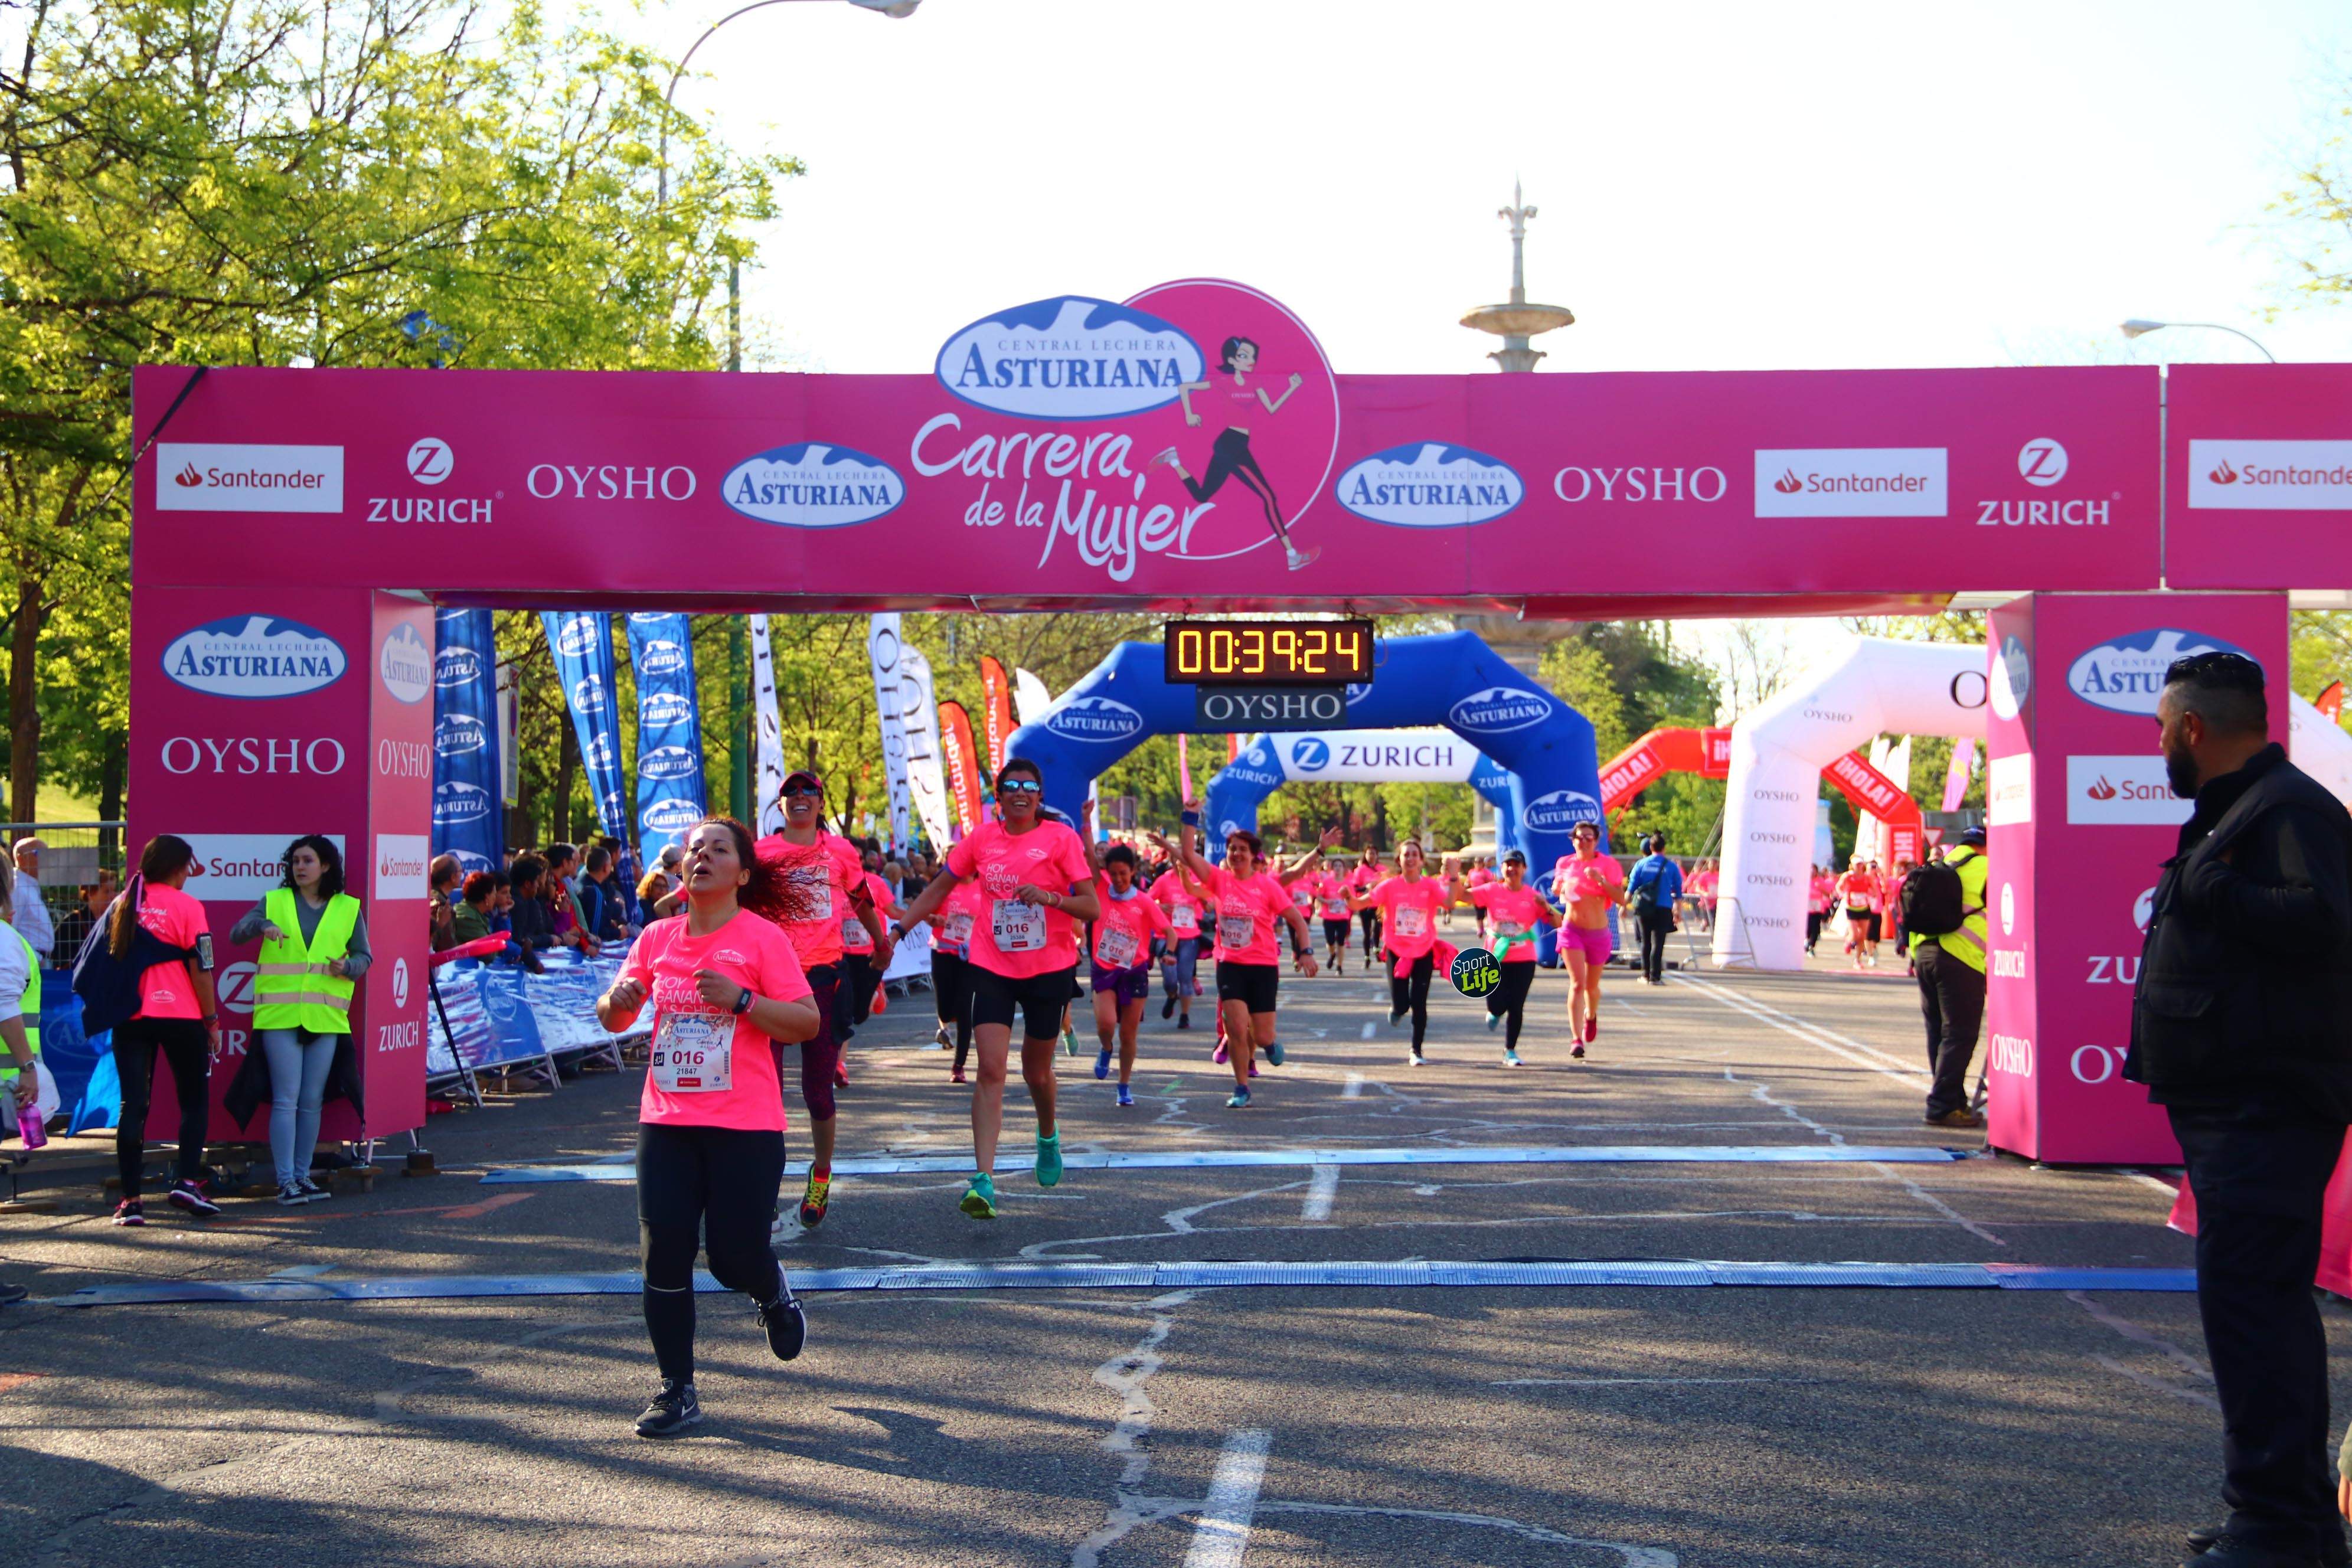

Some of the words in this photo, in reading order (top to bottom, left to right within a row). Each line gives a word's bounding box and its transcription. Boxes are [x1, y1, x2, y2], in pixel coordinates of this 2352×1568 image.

[998, 340, 1082, 351] CENTRAL
[1092, 340, 1176, 351] LECHERA
[955, 342, 1182, 388] ASTURIANA
[910, 413, 1132, 479] Carrera
[208, 468, 325, 489] Santander
[527, 464, 696, 500] OYSHO
[763, 471, 821, 480] CENTRAL
[827, 471, 886, 481] LECHERA
[1378, 471, 1436, 480] CENTRAL
[1443, 471, 1505, 480] LECHERA
[1554, 466, 1727, 502] OYSHO
[1807, 471, 1927, 494] Santander
[2243, 464, 2352, 486] Santande
[734, 472, 892, 506] ASTURIANA
[1348, 473, 1510, 507] ASTURIANA
[367, 498, 493, 524] ZURICH
[1977, 499, 2109, 526] ZURICH
[965, 482, 1005, 527] de
[1014, 481, 1044, 527] la
[1038, 472, 1216, 582] Mujer
[269, 643, 328, 652] LECHERA
[1179, 631, 1359, 673] 00:39:24
[175, 645, 334, 677] ASTURIANA
[384, 648, 428, 686] ASTURIANA
[1204, 694, 1341, 720] OYSHO
[1459, 704, 1545, 724] ASTURIANA
[1804, 710, 1853, 722] OYSHO
[1051, 712, 1135, 732] ASTURIANA
[161, 737, 345, 774] OYSHO
[379, 739, 430, 778] OYSHO
[1341, 746, 1453, 766] ZURICH
[1227, 767, 1278, 785] ZURICH
[1833, 756, 1894, 808] ¡HOLA!
[1755, 789, 1799, 802] OYSHO
[1529, 809, 1596, 825] ASTURIANA
[1751, 831, 1796, 845] OYSHO
[390, 858, 423, 877] Santander
[986, 864, 1006, 873] HOY
[986, 873, 1019, 884] GANAN
[1747, 874, 1794, 887] OYSHO
[1006, 923, 1029, 934] 016
[1744, 916, 1790, 929] OYSHO
[1227, 931, 1242, 939] 016
[715, 953, 744, 963] ASTURIANA
[1109, 945, 1125, 956] 016
[1994, 949, 2026, 978] ZURICH
[658, 976, 687, 989] HOY
[656, 989, 704, 1004] GANAN
[378, 1020, 419, 1053] ZURICH
[674, 1025, 709, 1035] ASTURIANA
[672, 1050, 704, 1064] 016
[1991, 1033, 2032, 1077] OYSHO
